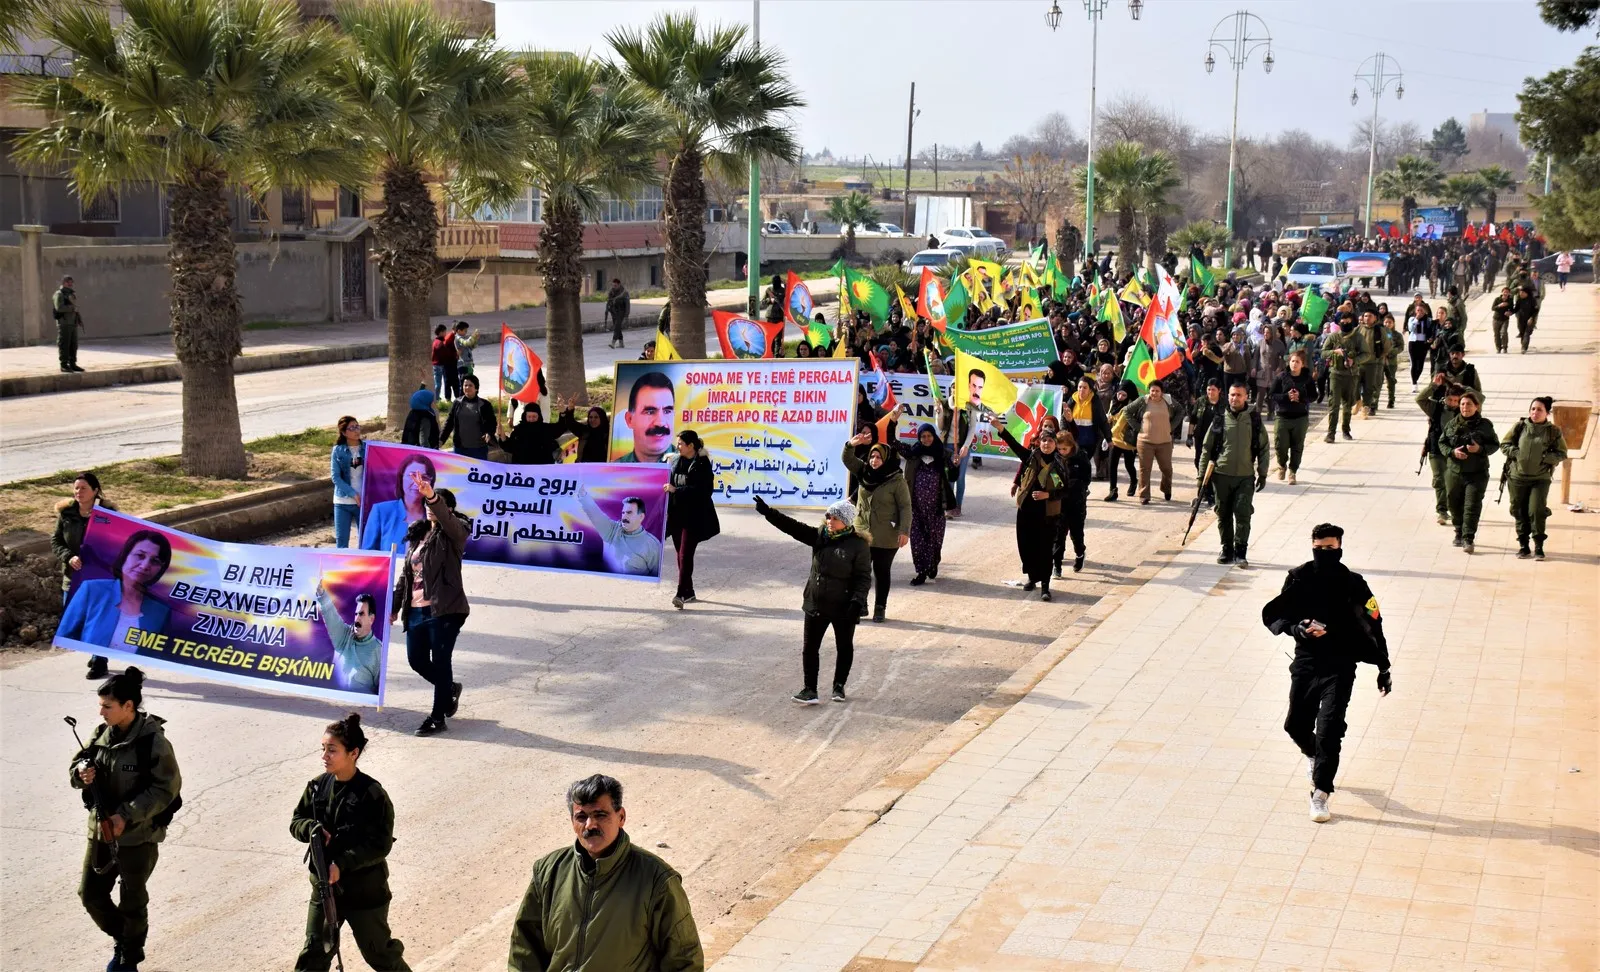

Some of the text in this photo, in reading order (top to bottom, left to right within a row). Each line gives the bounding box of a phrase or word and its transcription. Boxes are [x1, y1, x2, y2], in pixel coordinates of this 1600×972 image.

[1031, 331, 1043, 340] APO
[685, 372, 724, 385] SONDA
[726, 371, 743, 384] ME
[746, 371, 762, 384] YE
[771, 368, 796, 384] EMÊ
[798, 370, 853, 384] PERGALA
[749, 390, 787, 407] PERÇE
[793, 390, 827, 404] BIKIN
[682, 407, 848, 423] BI RÊBER APO RE AZAD BIJIN
[734, 436, 761, 451] علينا
[748, 458, 785, 474] النظام
[786, 459, 816, 475] نهدم
[817, 458, 829, 475] أن
[467, 467, 578, 496] بروح مقاومة
[801, 481, 843, 499] ونعيش
[725, 484, 750, 498] مع
[752, 482, 800, 499] حريتنا
[482, 498, 553, 517] السجون
[513, 523, 584, 544] سنحطم
[223, 563, 295, 588] BI RIHÊ
[170, 581, 320, 621] BERXWEDANA
[192, 612, 286, 647] ZINDANA
[124, 627, 335, 681] EME TECRÊDE BIŞKÎNIN
